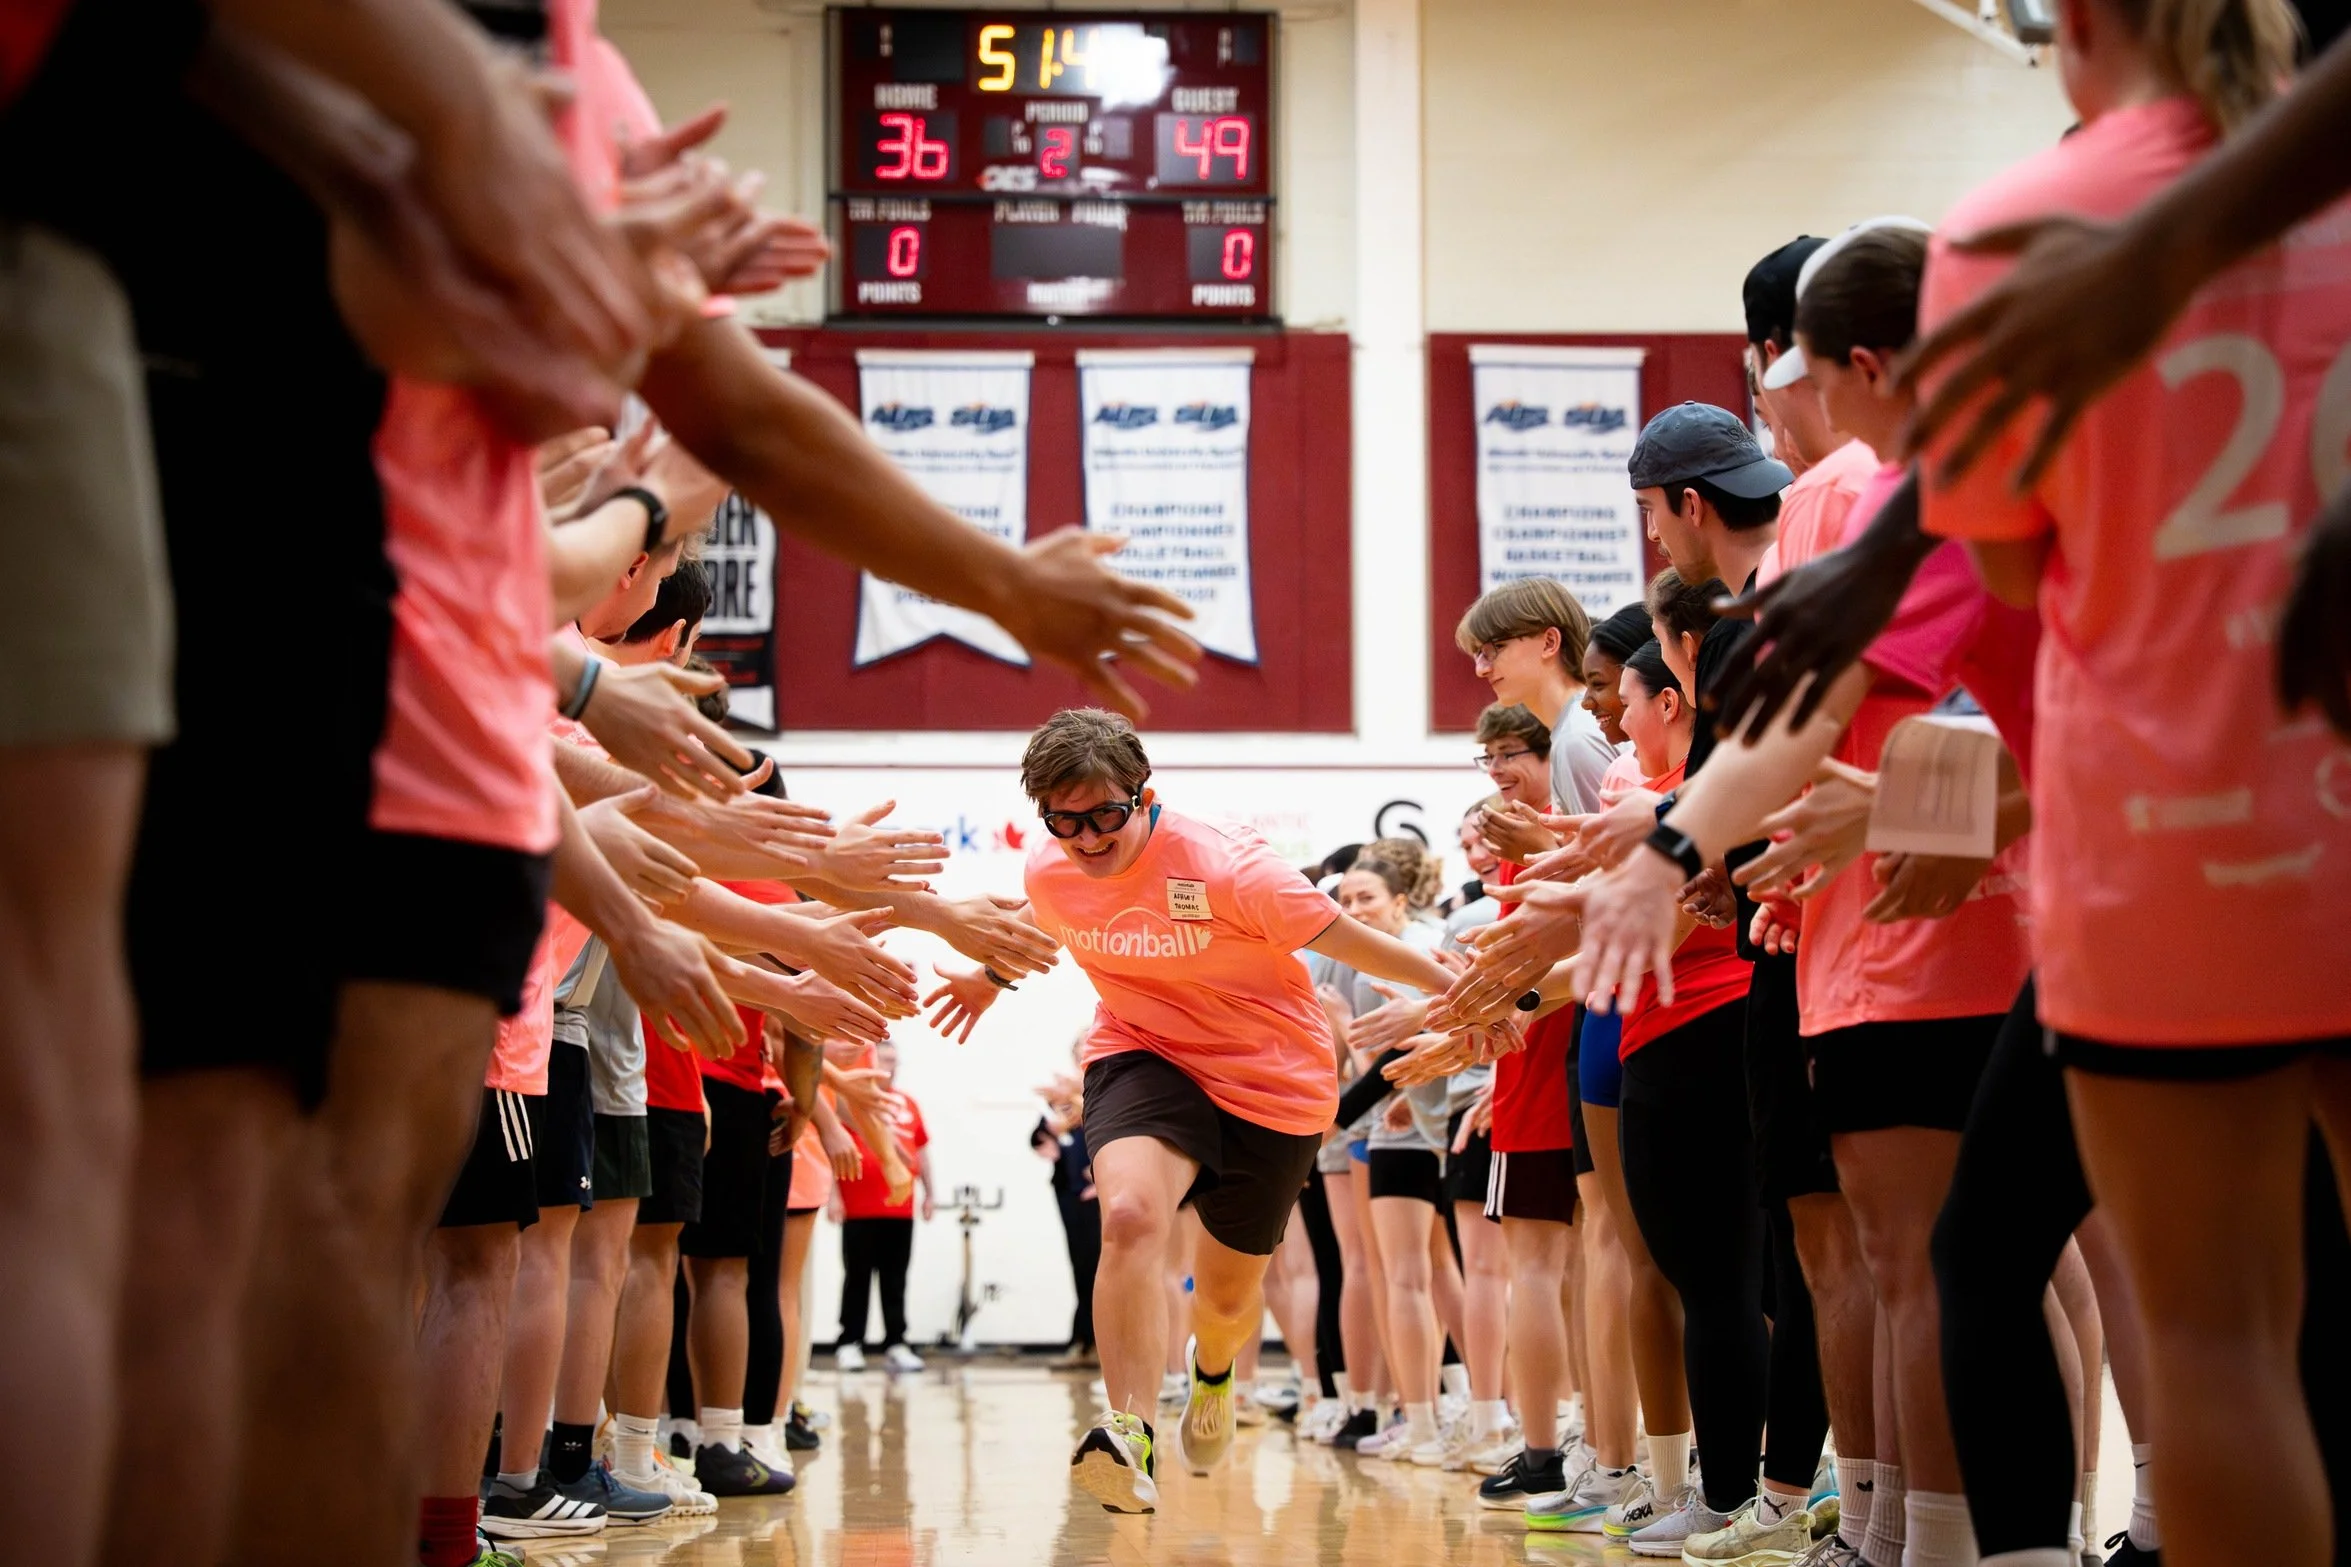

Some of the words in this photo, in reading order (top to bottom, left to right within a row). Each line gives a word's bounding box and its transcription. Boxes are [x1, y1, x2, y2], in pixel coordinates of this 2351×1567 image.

[874, 84, 937, 110] HOME
[1172, 87, 1238, 112] GUEST
[1025, 102, 1088, 123] PERIOD
[875, 113, 949, 180] 36
[1041, 128, 1073, 178] 2
[1174, 116, 1250, 180] 49
[888, 226, 920, 277] 0
[1222, 228, 1254, 279] 0
[858, 282, 922, 304] POINTS
[1192, 284, 1255, 306] POINTS
[1059, 924, 1197, 957] motionball
[1623, 1502, 1653, 1523] HOKA
